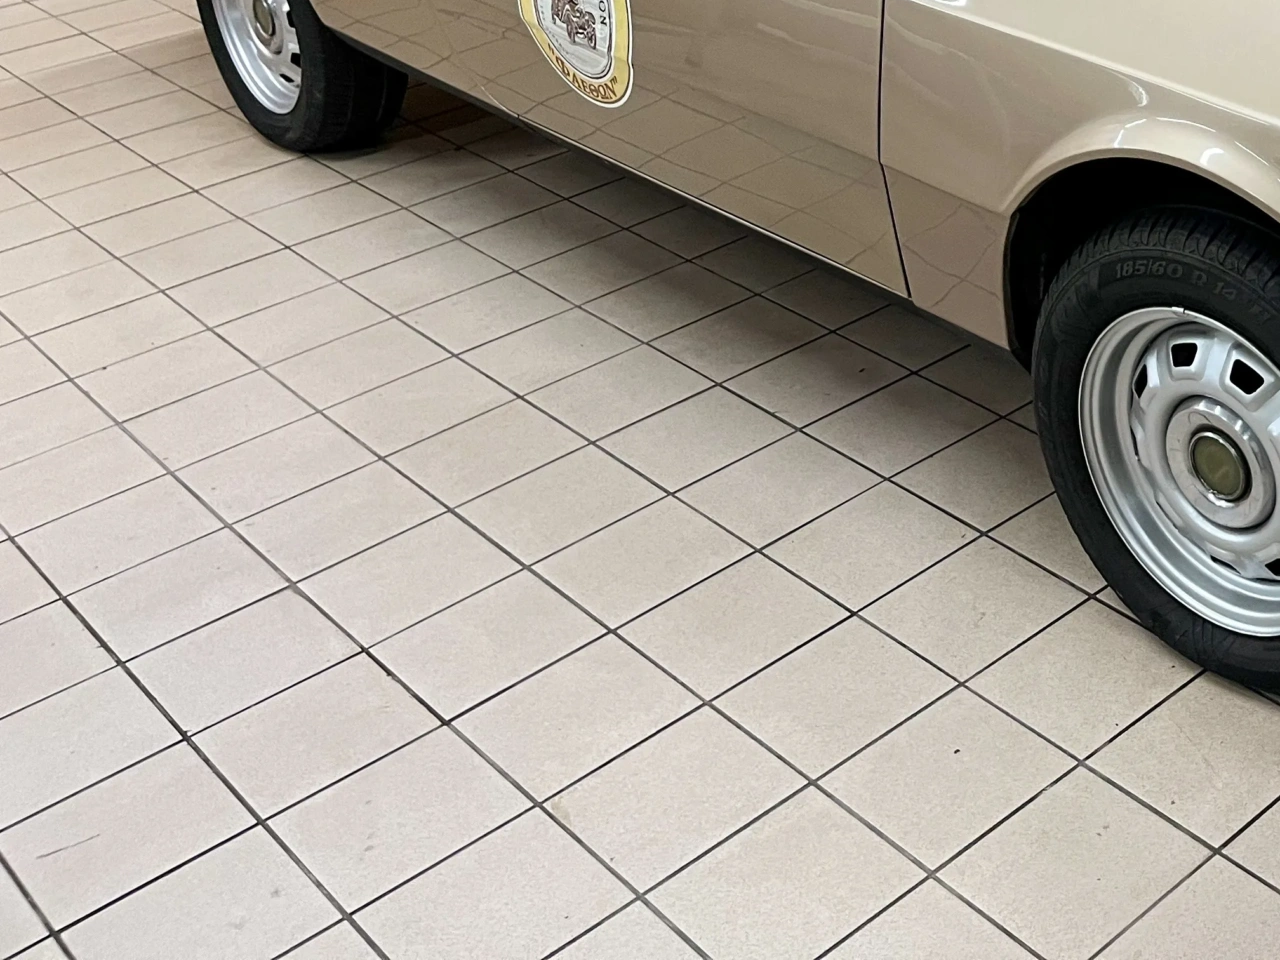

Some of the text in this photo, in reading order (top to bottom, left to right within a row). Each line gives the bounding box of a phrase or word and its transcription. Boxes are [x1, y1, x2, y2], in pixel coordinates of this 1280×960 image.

[1115, 258, 1182, 280] 185/60
[1189, 269, 1206, 288] R
[1213, 280, 1238, 302] 14
